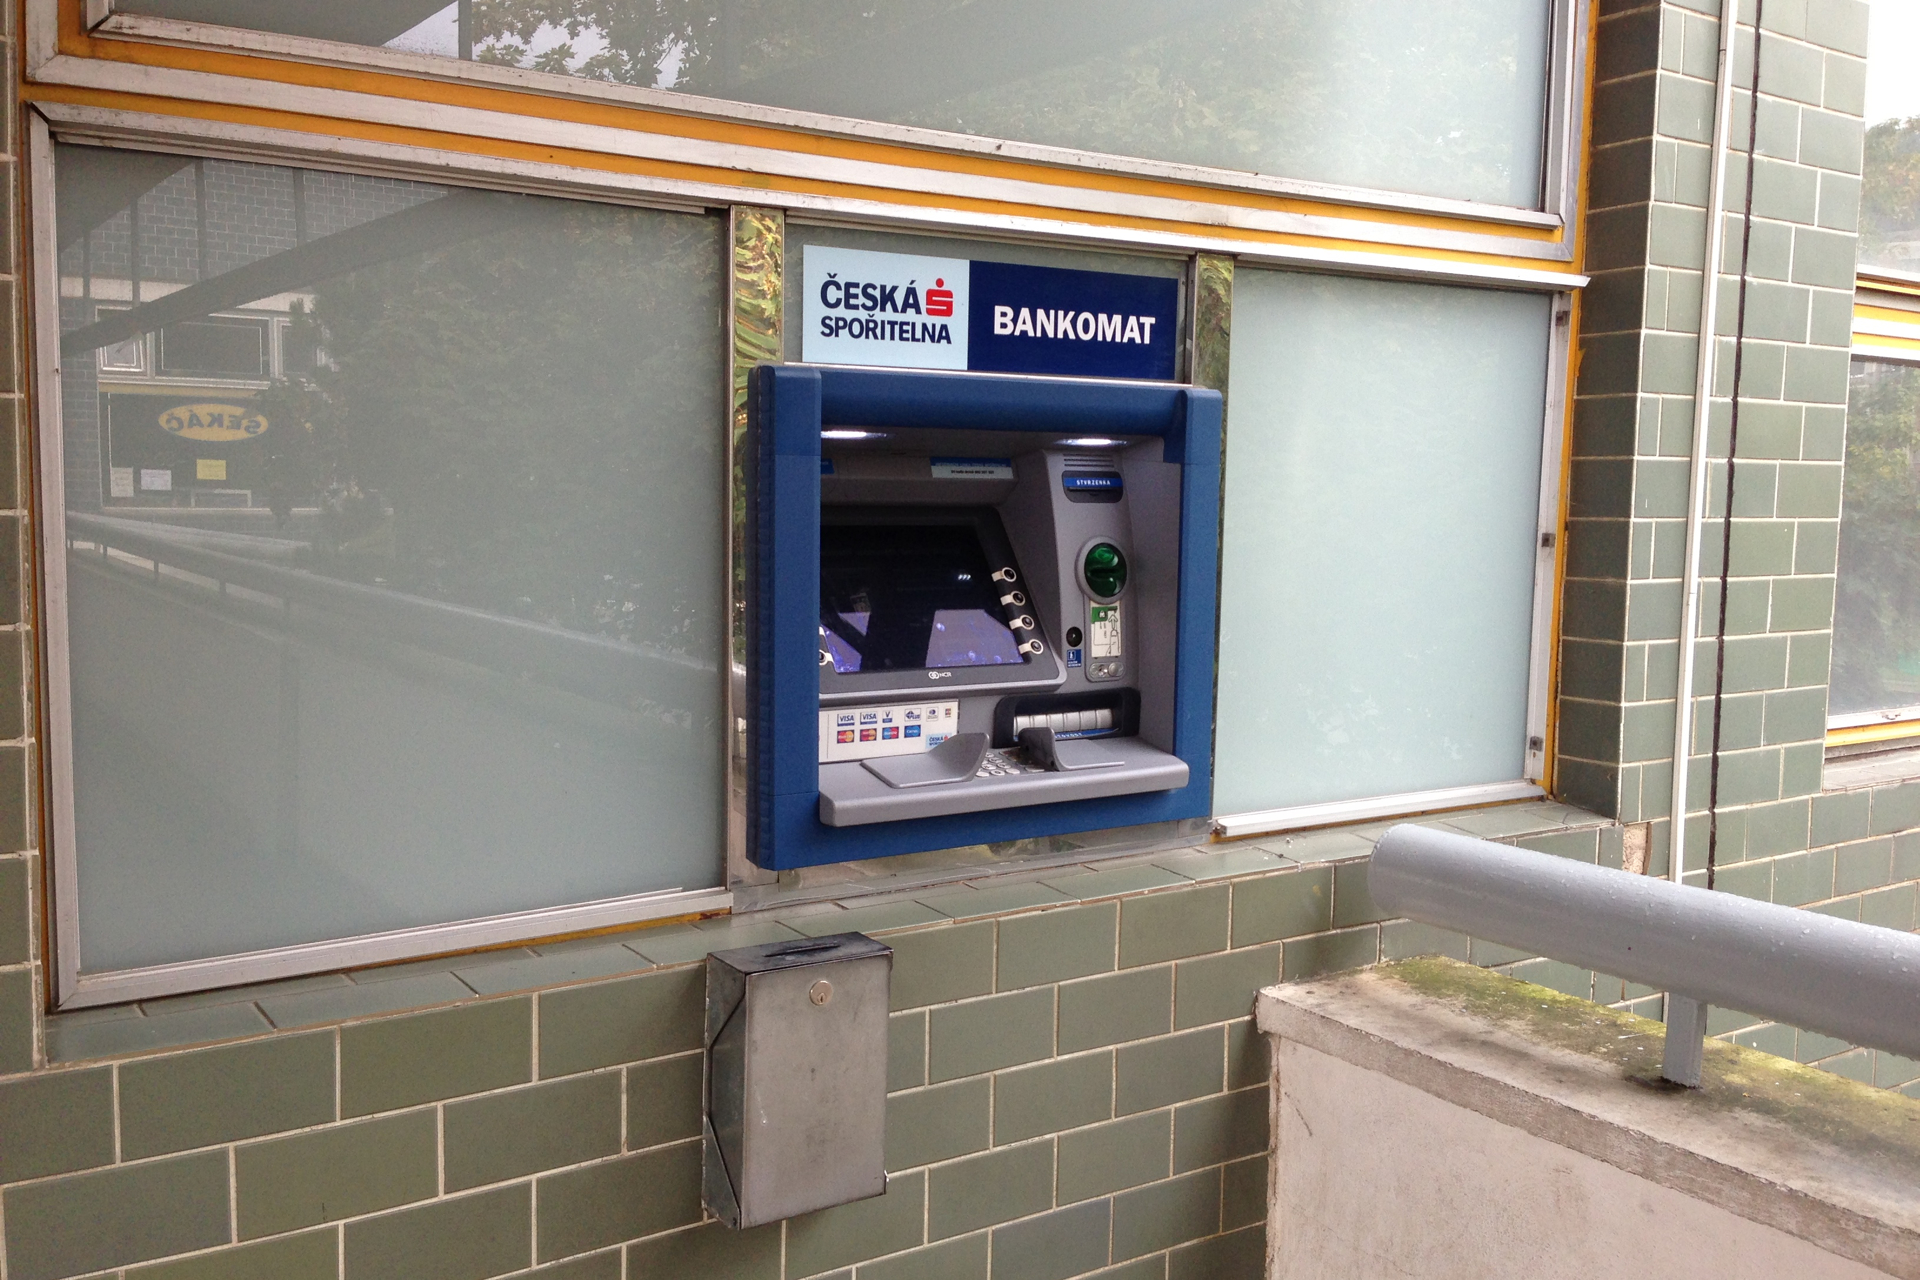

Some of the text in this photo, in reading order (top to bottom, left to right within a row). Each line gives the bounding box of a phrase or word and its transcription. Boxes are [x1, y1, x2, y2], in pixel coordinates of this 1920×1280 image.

[820, 272, 922, 315] ČESKÁ
[820, 313, 953, 345] SPOŘITELNA
[993, 305, 1156, 345] BANKOMAT
[840, 714, 855, 722] VISA
